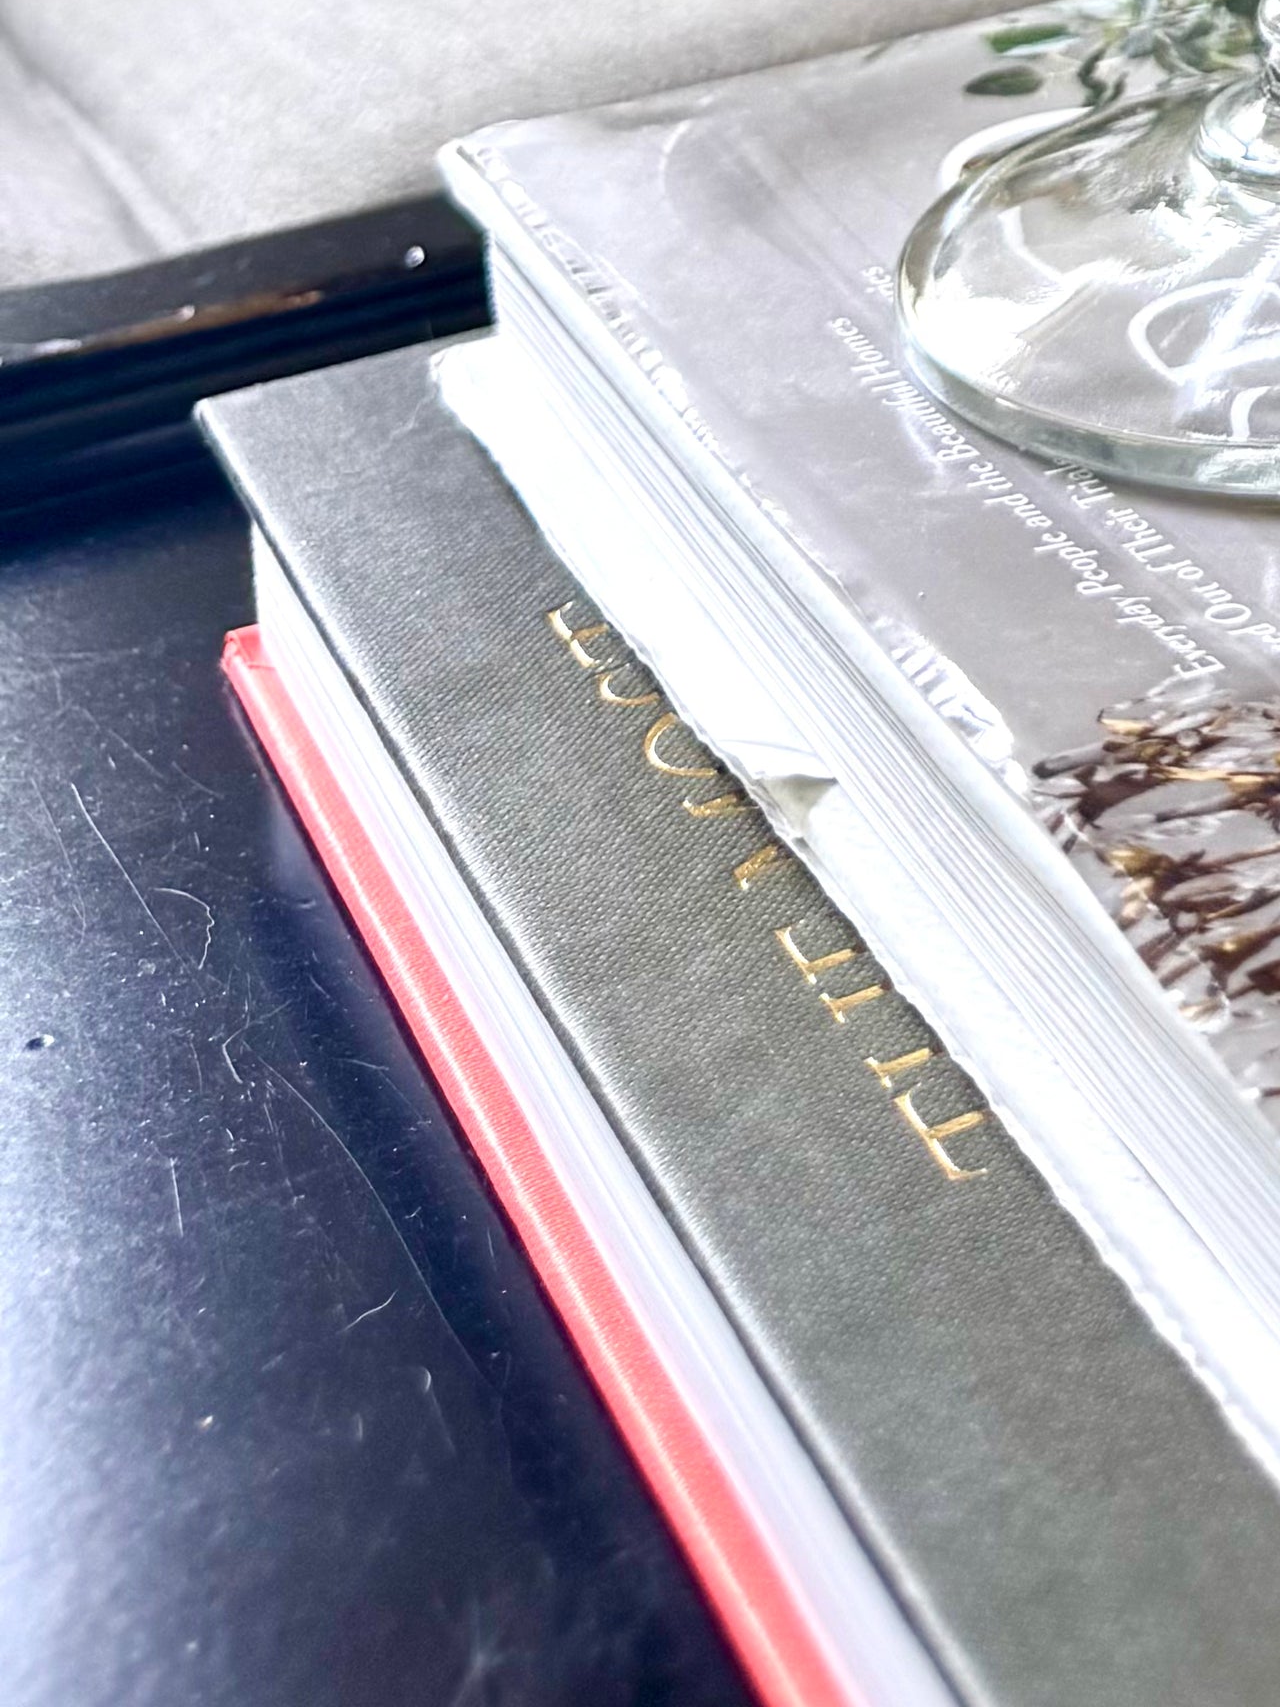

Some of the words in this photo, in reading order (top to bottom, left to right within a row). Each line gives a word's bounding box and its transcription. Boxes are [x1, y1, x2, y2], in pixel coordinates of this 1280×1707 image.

[828, 316, 901, 385] Homes
[870, 379, 981, 463] Beautiful
[965, 459, 1014, 490] the
[982, 491, 1054, 530] and
[1104, 507, 1176, 564] Their
[1033, 529, 1125, 598] People
[1145, 558, 1205, 582] of
[1191, 580, 1252, 625] Out
[1109, 595, 1227, 680] Everyday
